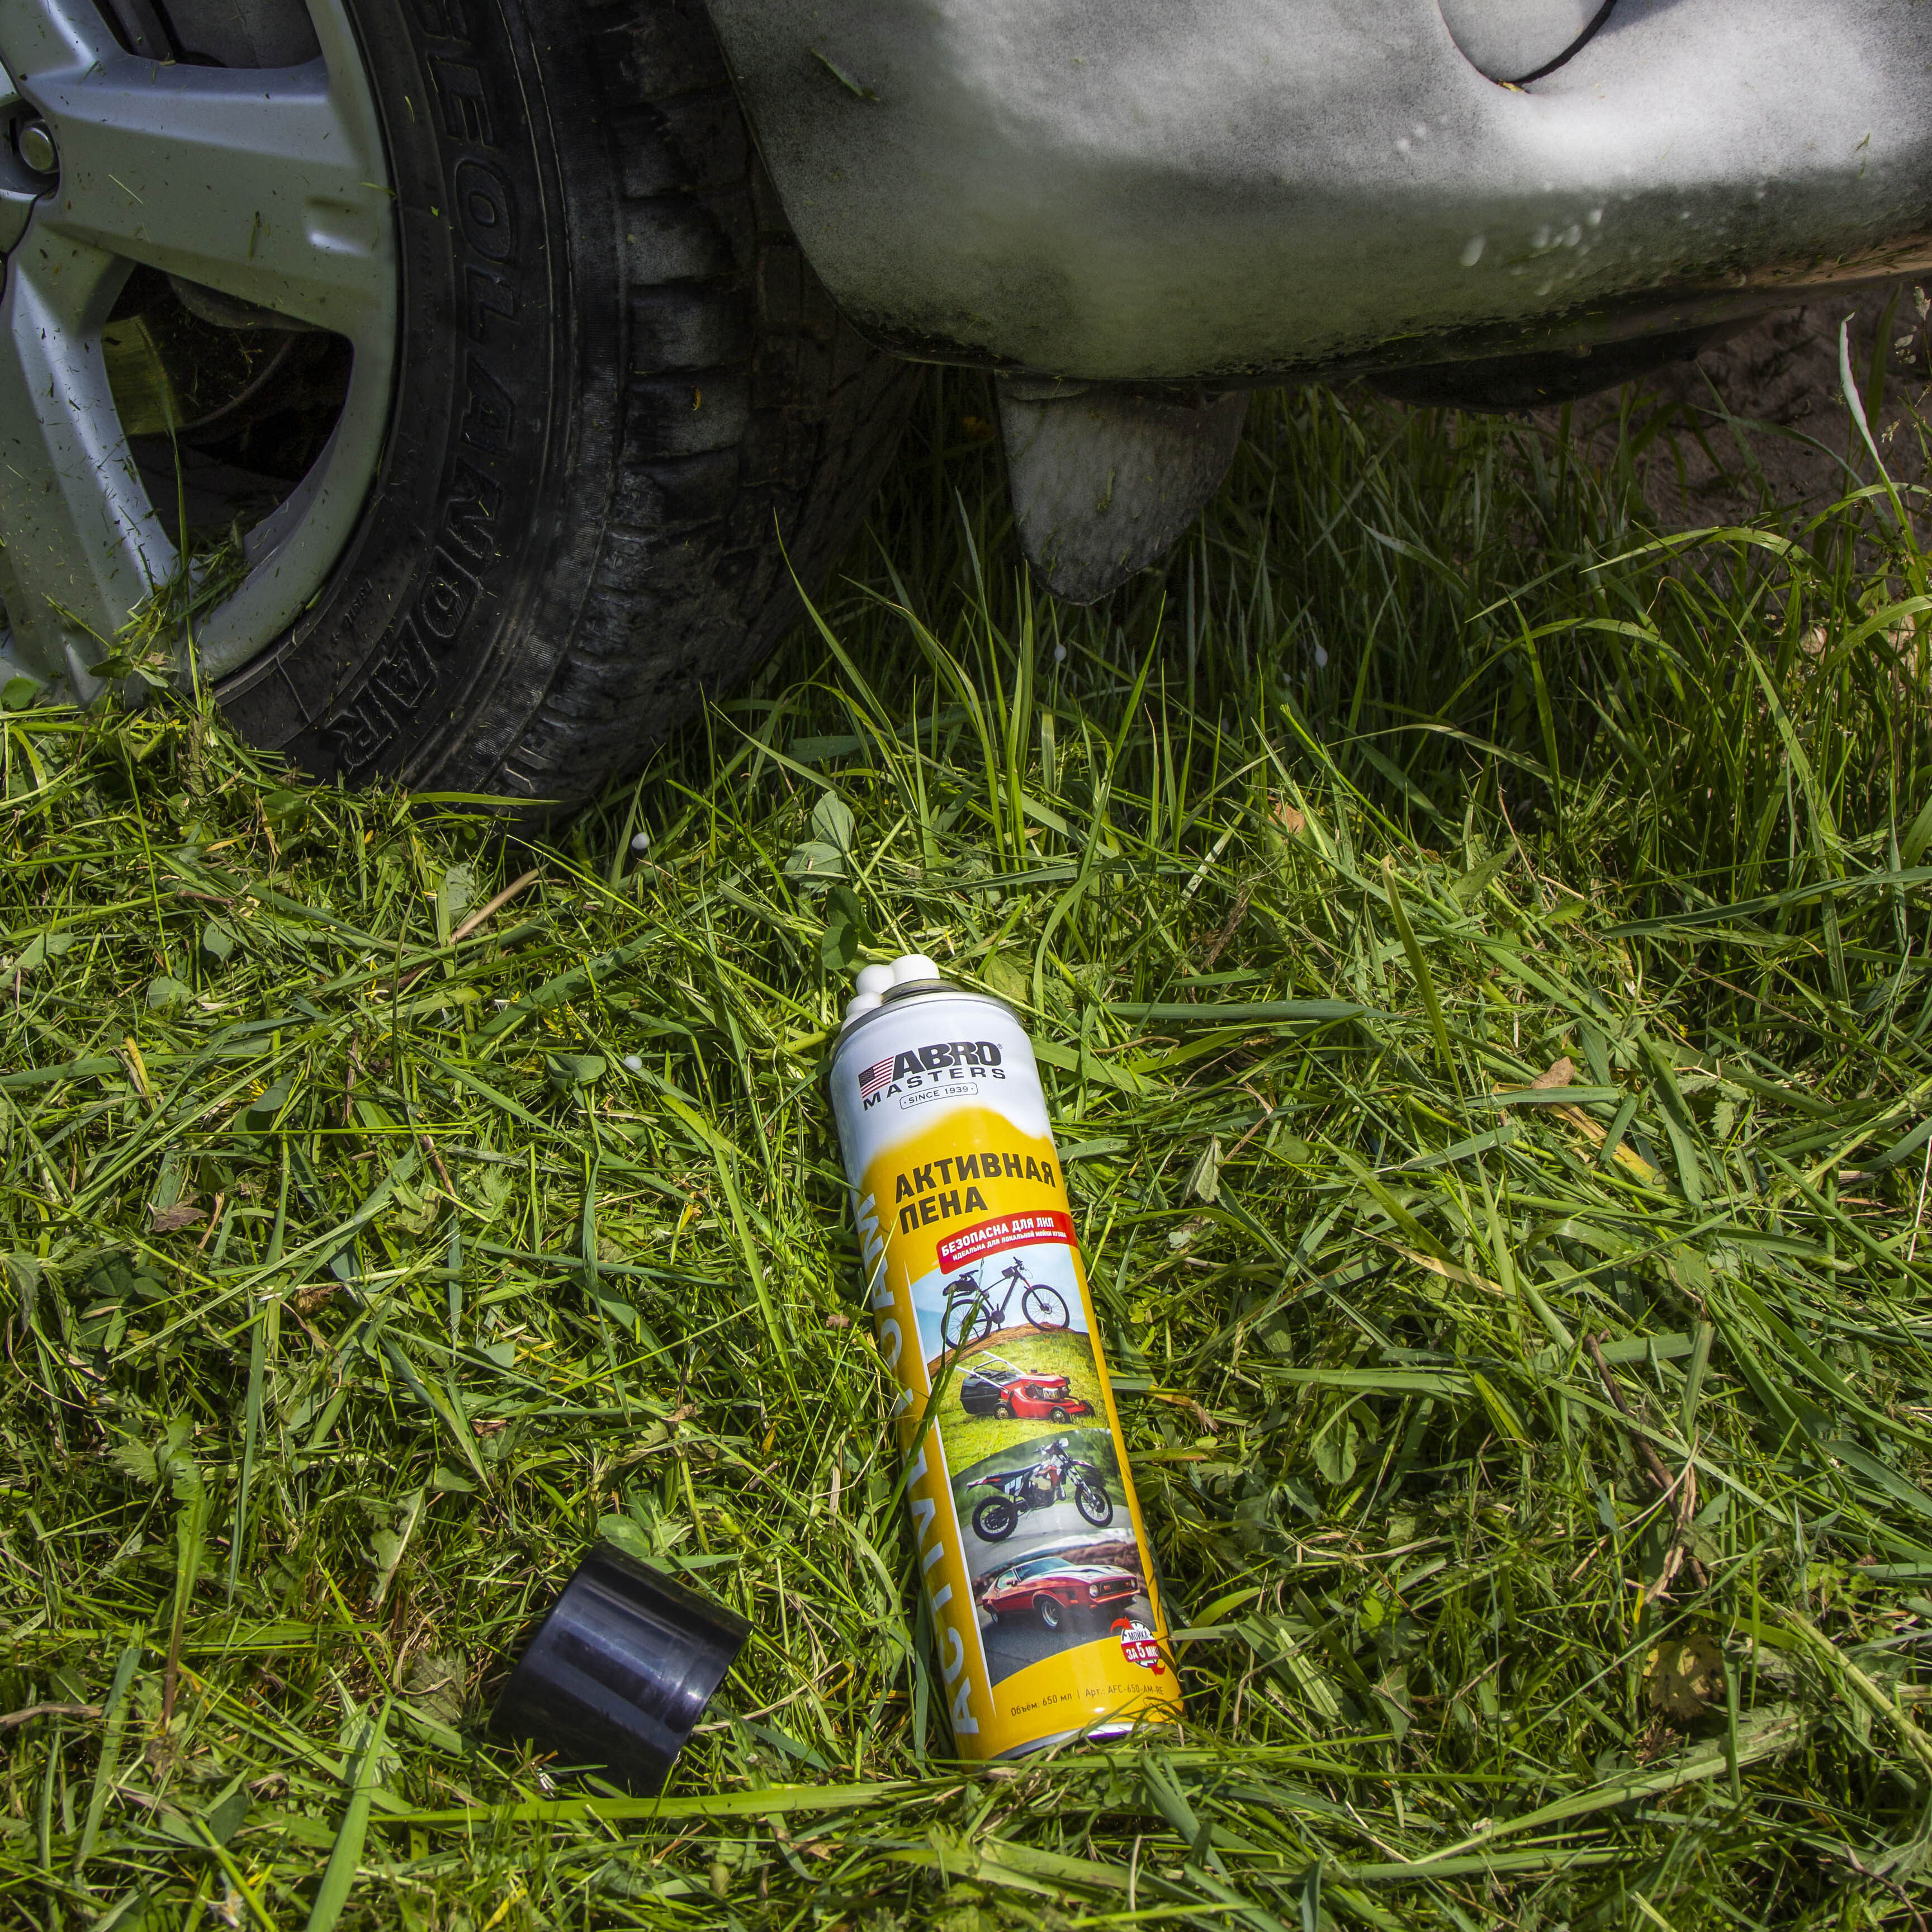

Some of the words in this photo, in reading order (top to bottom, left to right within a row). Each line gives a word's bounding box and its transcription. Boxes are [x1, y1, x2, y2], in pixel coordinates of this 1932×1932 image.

[892, 1041, 1002, 1082] ABRO
[863, 1067, 1006, 1111] MASTERS
[908, 1090, 940, 1104] SINCE
[944, 1086, 969, 1095] 1939
[895, 1152, 1056, 1204] АКТИВНАЯ
[898, 1186, 988, 1235] ПЕНА
[941, 1223, 1010, 1257] БЕЗОПАСНА
[1012, 1218, 1034, 1233] ДЛЯ
[1036, 1217, 1054, 1228] ЛКП
[953, 1244, 986, 1261] ИДЕАЛЬНА
[987, 1239, 1000, 1248] ДЛЯ
[1001, 1231, 1034, 1243] ЛОКАЛЬНОЙ
[1125, 1648, 1139, 1660] ЗА
[1135, 1642, 1145, 1658] 5
[1128, 1630, 1149, 1641] МОЙКА
[1011, 1703, 1039, 1716] Объём:
[1043, 1694, 1058, 1706] 650
